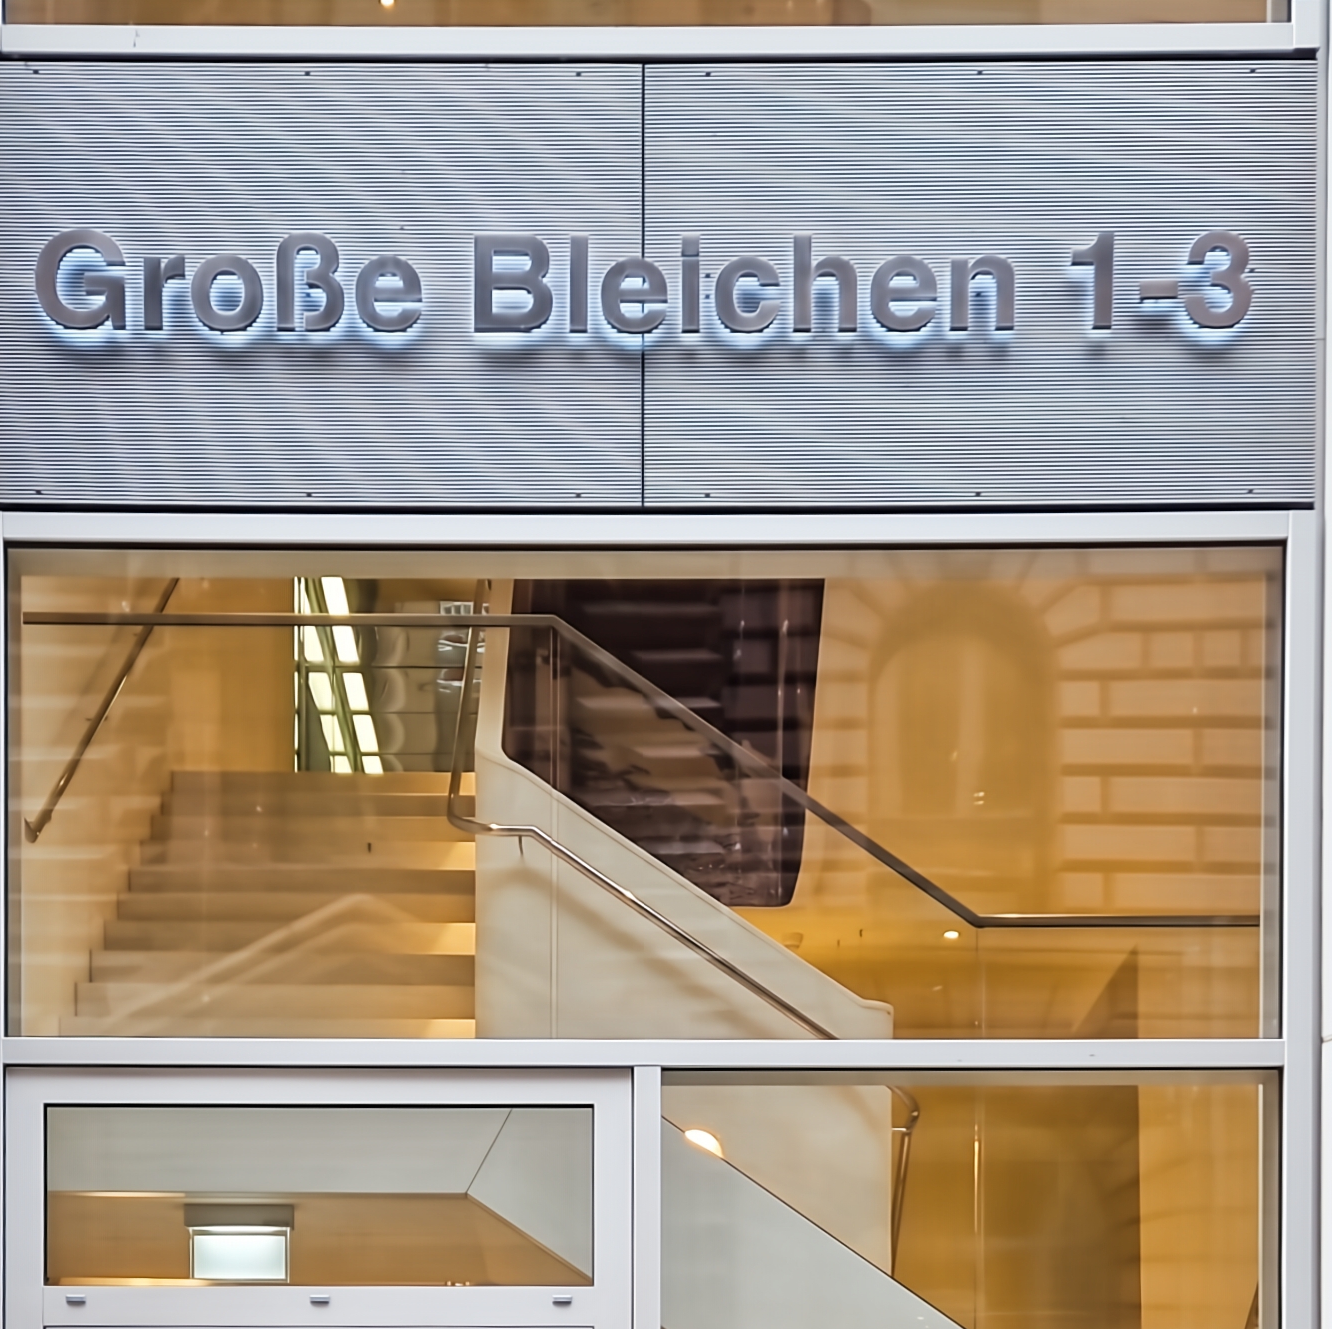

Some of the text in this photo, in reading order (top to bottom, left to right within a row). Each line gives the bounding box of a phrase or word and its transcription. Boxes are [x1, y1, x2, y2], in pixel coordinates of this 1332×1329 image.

[35, 228, 1255, 333] Große Bleichen 1-3
